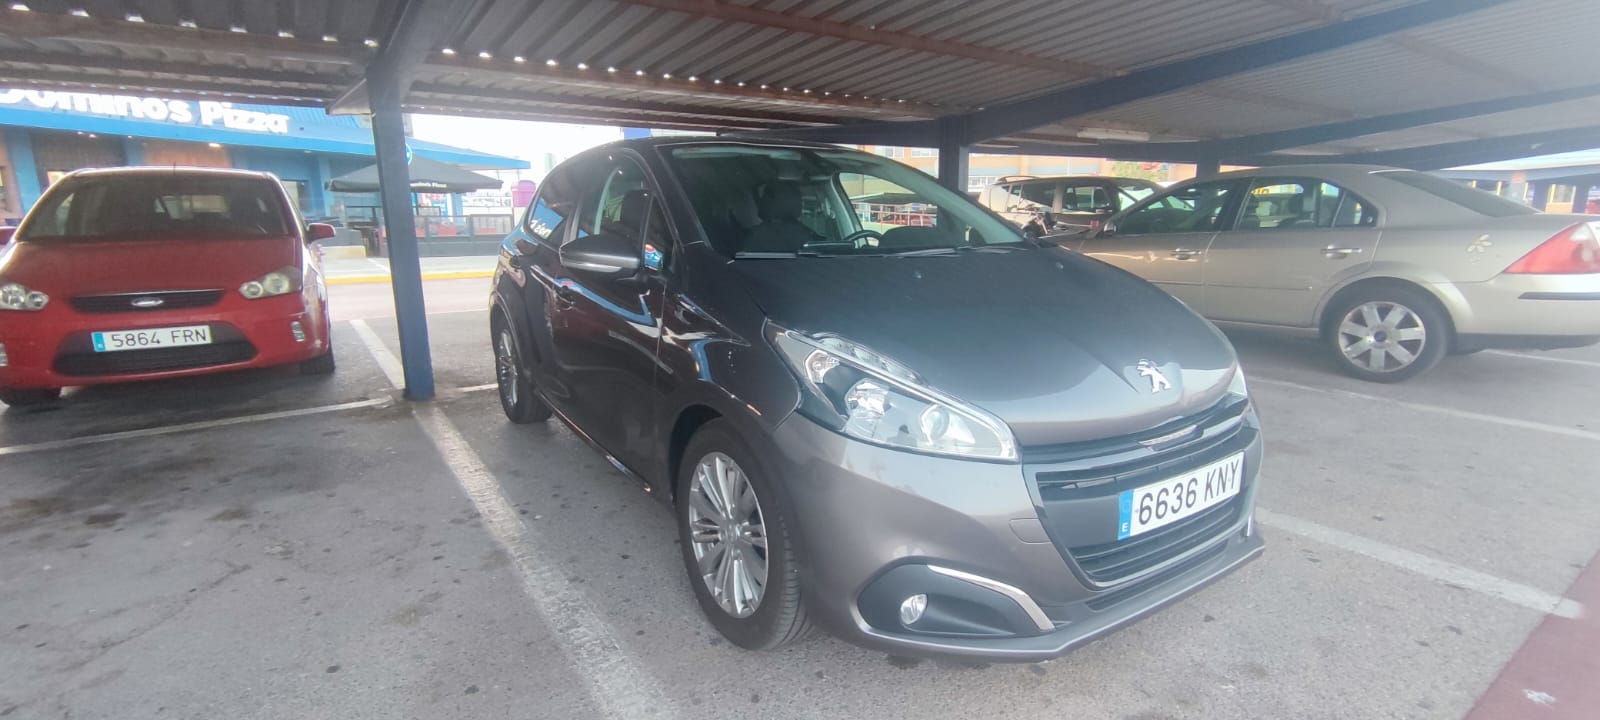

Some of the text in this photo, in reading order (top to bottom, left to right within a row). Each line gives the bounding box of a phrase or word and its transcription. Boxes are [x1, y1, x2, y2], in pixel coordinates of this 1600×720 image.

[199, 101, 289, 133] Pizza
[111, 329, 207, 348] 5864 FRN
[1138, 459, 1240, 525] 6636 KNY
[1122, 522, 1129, 532] E
